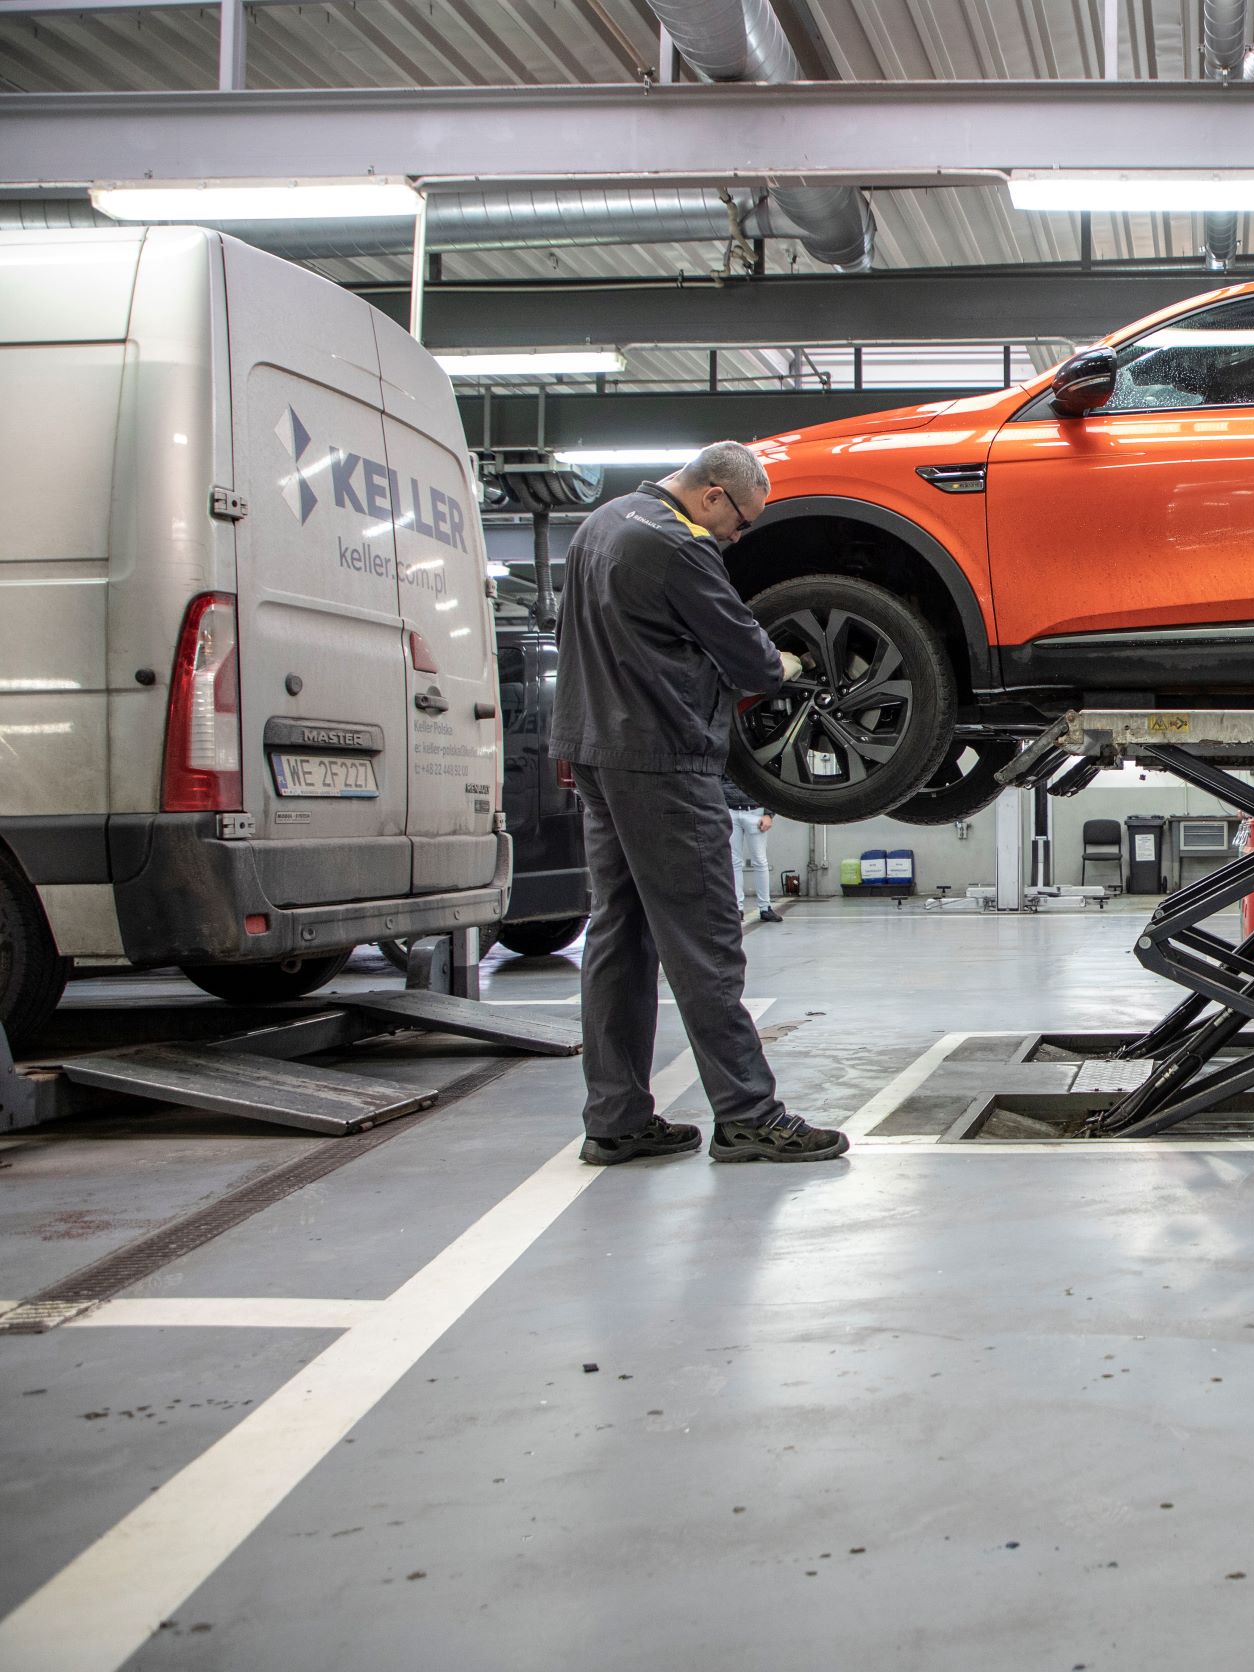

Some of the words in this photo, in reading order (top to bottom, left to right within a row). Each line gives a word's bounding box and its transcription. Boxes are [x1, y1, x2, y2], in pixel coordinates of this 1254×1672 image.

[329, 445, 468, 553] KELLER
[633, 514, 662, 530] RENAULT
[337, 536, 447, 597] keller.com.pl
[303, 729, 363, 746] MASTER
[414, 720, 432, 734] Keller
[433, 722, 453, 736] Polska
[286, 758, 315, 787] WE
[318, 760, 368, 789] 2F227
